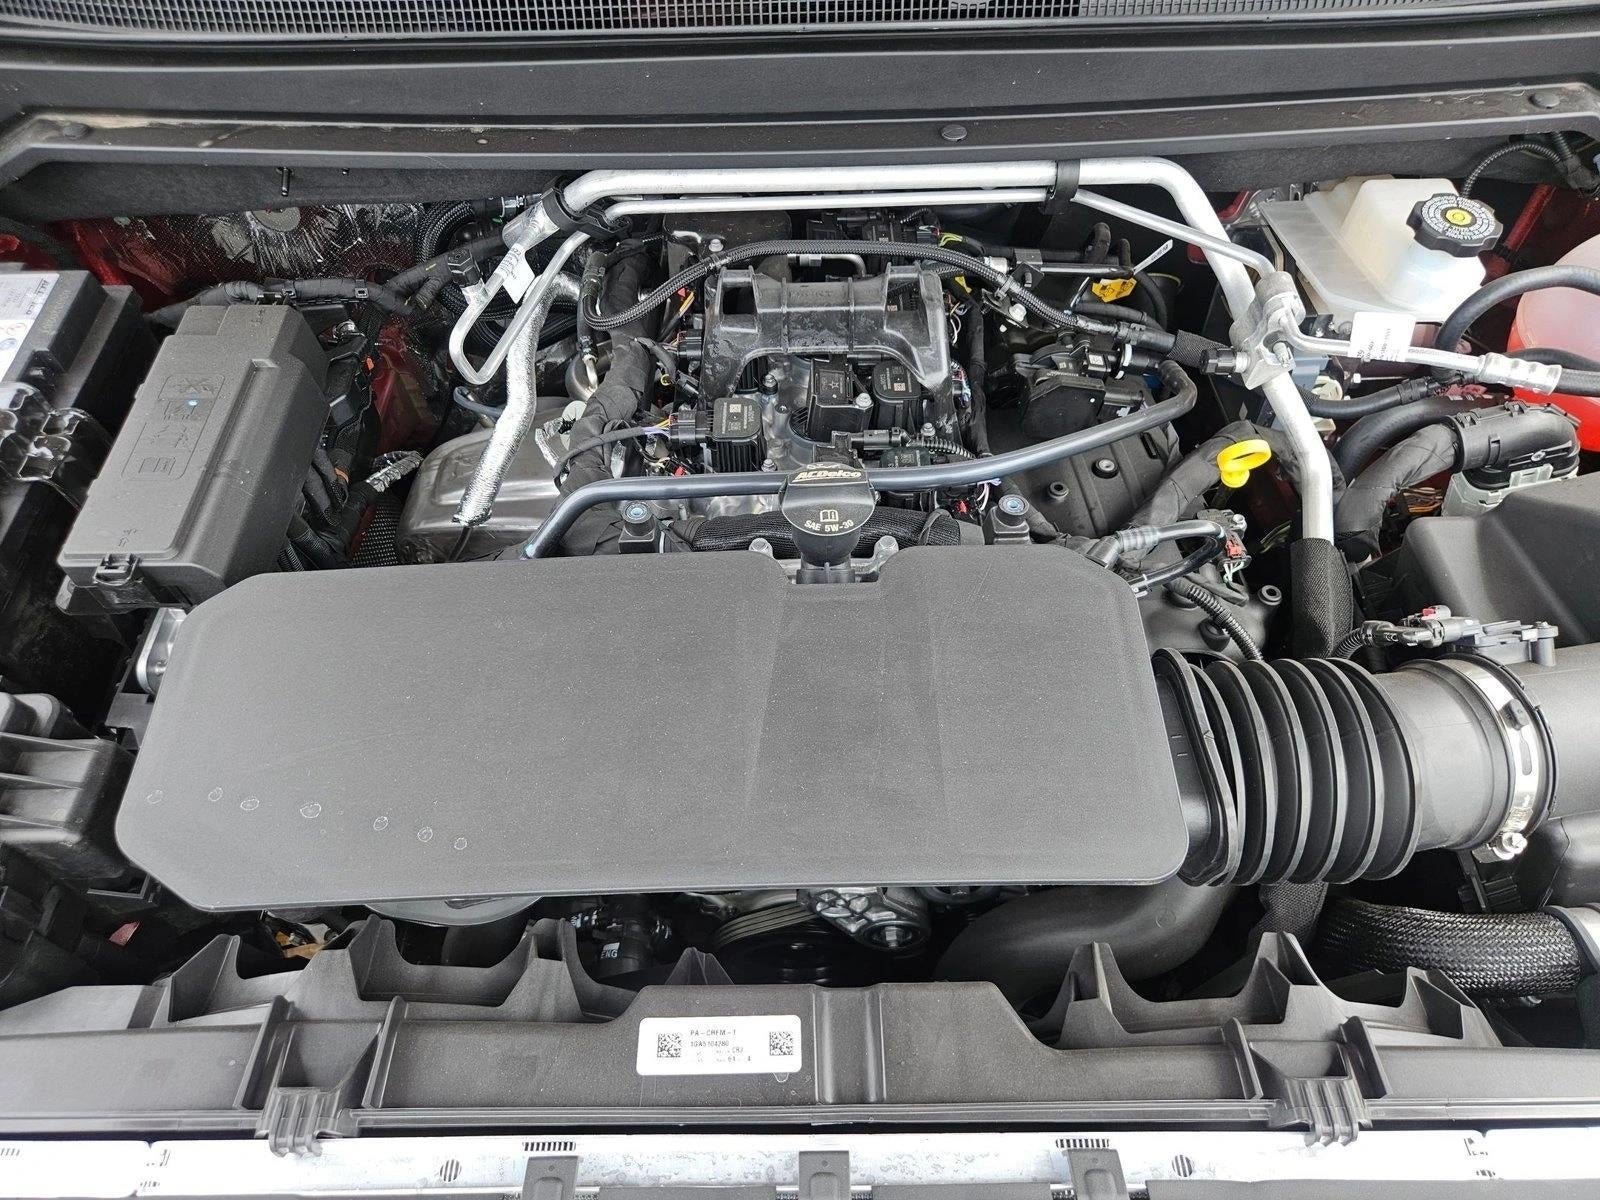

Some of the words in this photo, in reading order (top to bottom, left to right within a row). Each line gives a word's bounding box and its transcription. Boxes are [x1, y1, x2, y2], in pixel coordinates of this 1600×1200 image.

[792, 470, 862, 482] ACDelco
[804, 520, 822, 531] SAE
[824, 520, 855, 533] 5W-30
